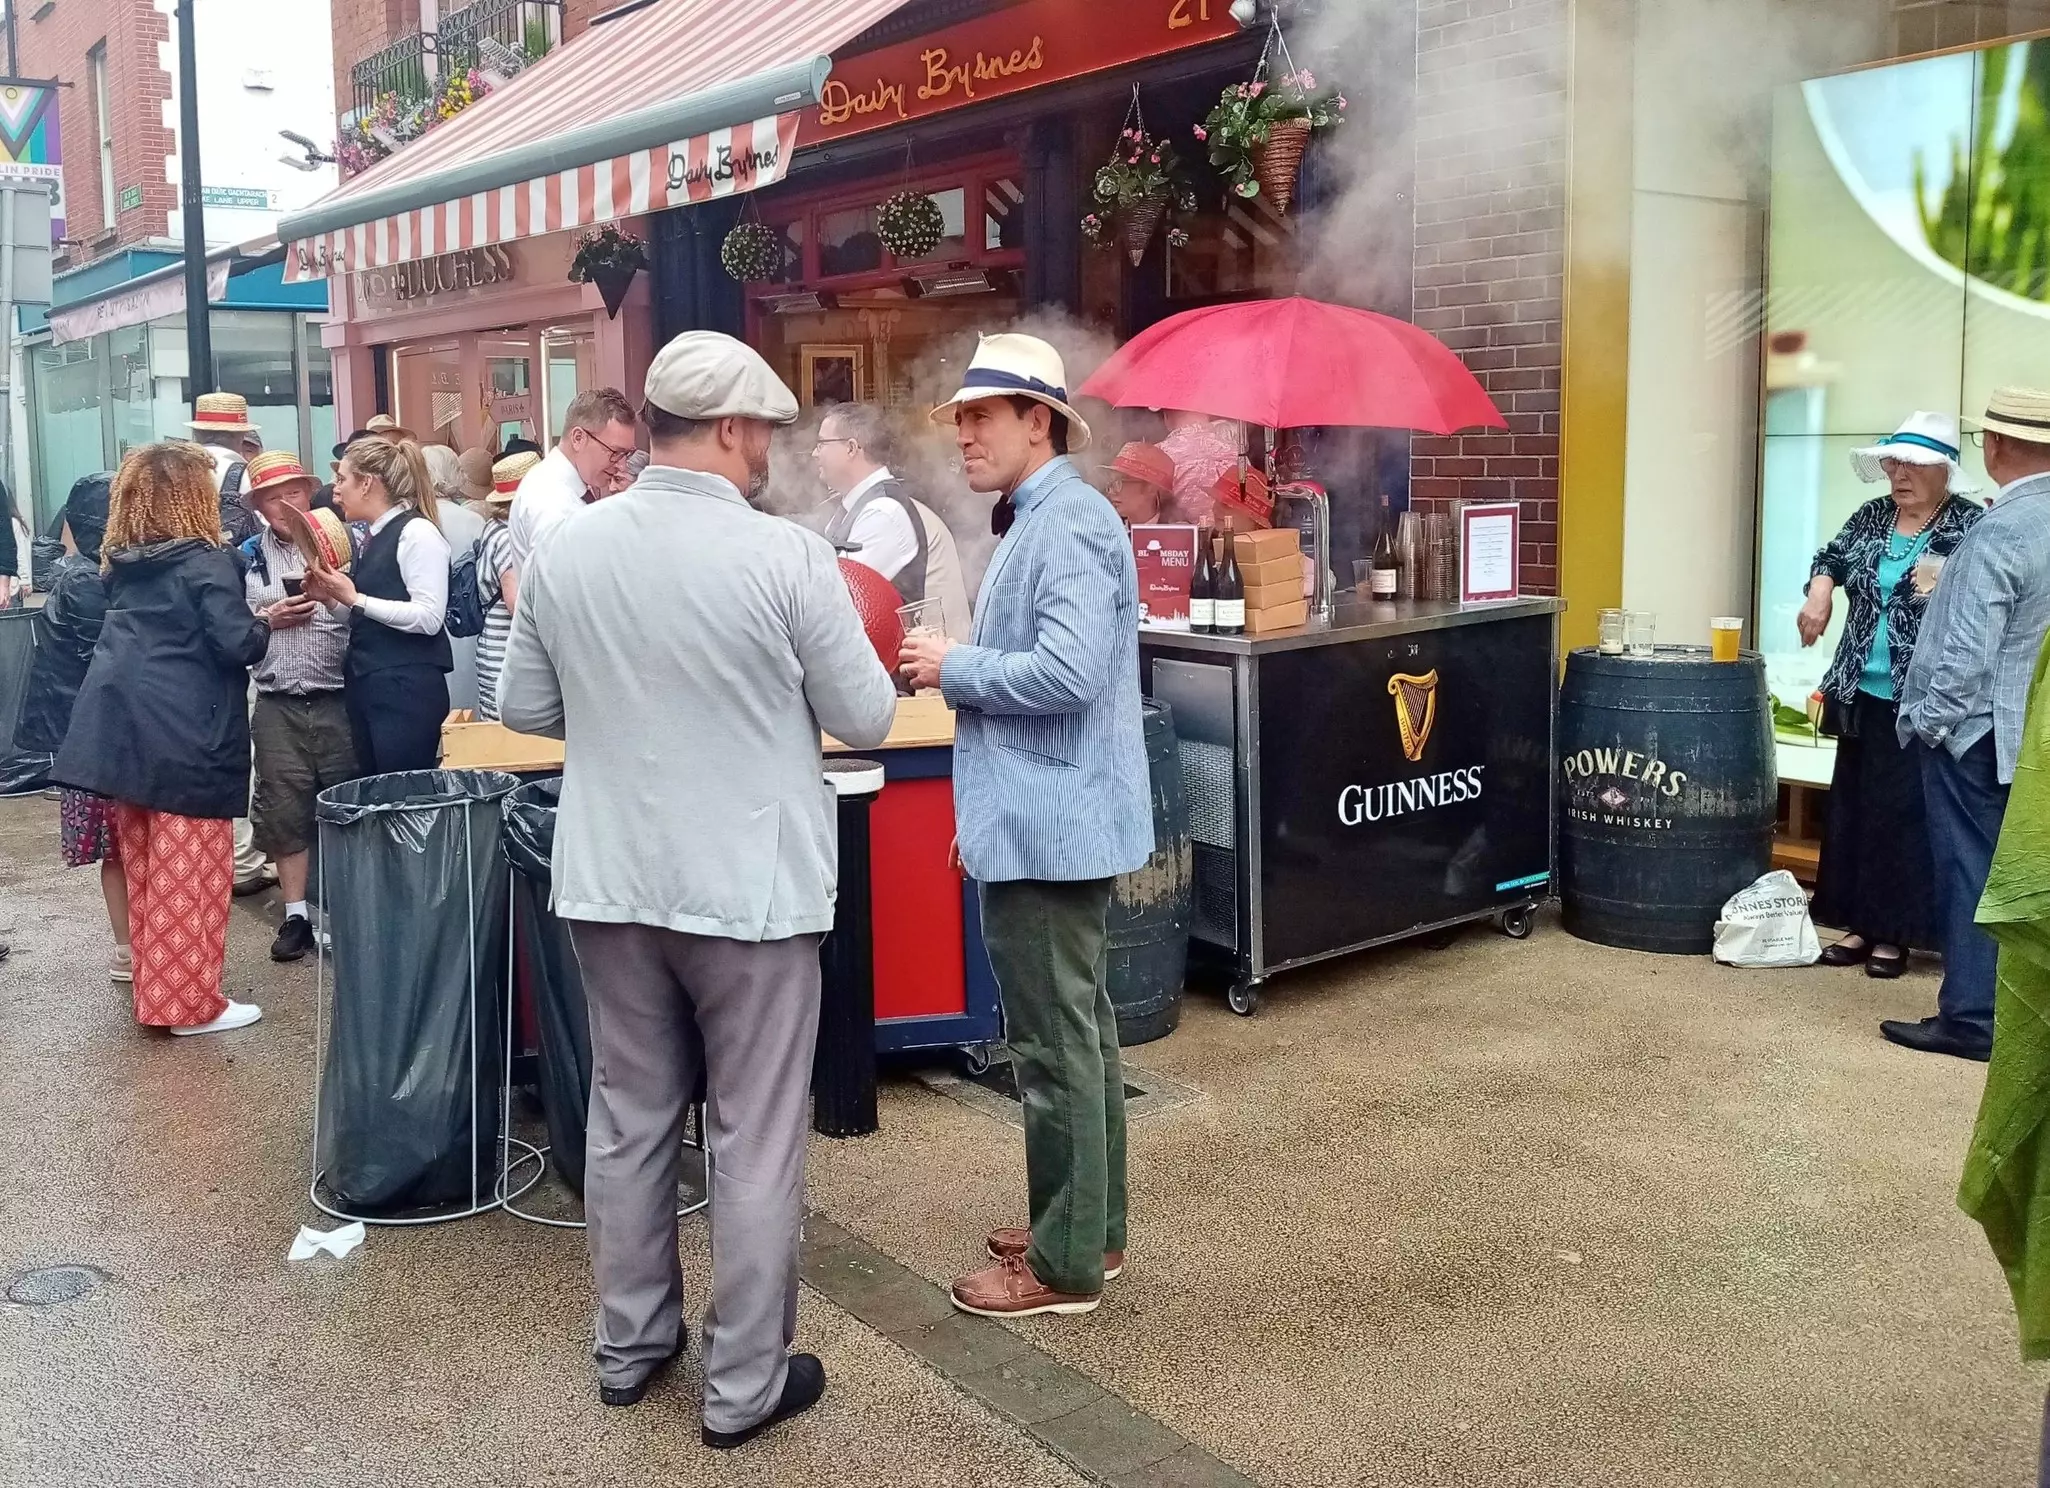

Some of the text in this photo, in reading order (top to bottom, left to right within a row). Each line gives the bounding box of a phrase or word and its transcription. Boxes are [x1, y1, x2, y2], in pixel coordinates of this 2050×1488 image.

[820, 35, 1045, 126] Davy Byrnes
[24, 167, 60, 176] PRIDE
[665, 144, 779, 191] Davy Byrnes
[236, 198, 260, 206] UPPER
[272, 193, 278, 204] 2
[1161, 557, 1189, 567] MENU
[1563, 747, 1688, 797] POWERS
[1337, 765, 1483, 826] GUINNESS
[1567, 807, 1672, 829] IRISH WHISKEY
[1765, 911, 1784, 920] Better
